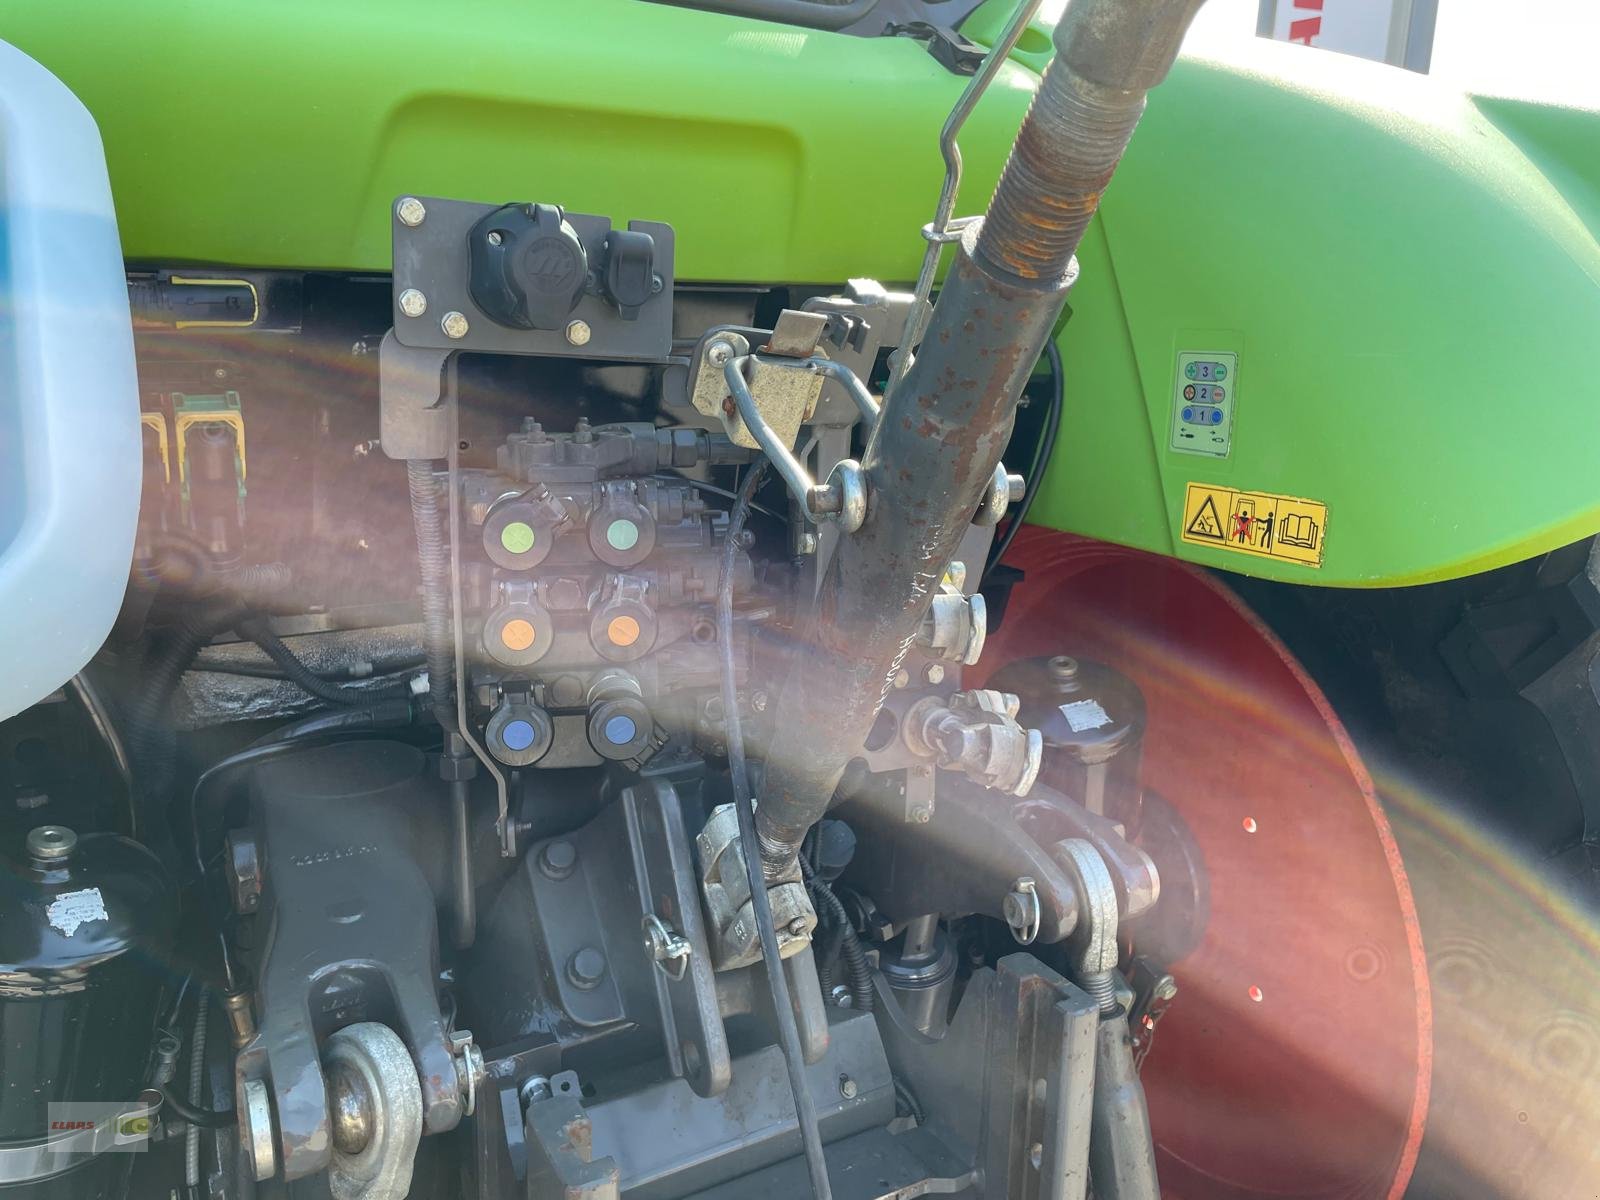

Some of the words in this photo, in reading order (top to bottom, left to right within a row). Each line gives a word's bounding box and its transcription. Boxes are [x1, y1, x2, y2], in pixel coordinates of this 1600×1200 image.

[1202, 366, 1209, 378] 3
[1200, 388, 1207, 399] 2
[1199, 410, 1205, 421] 1
